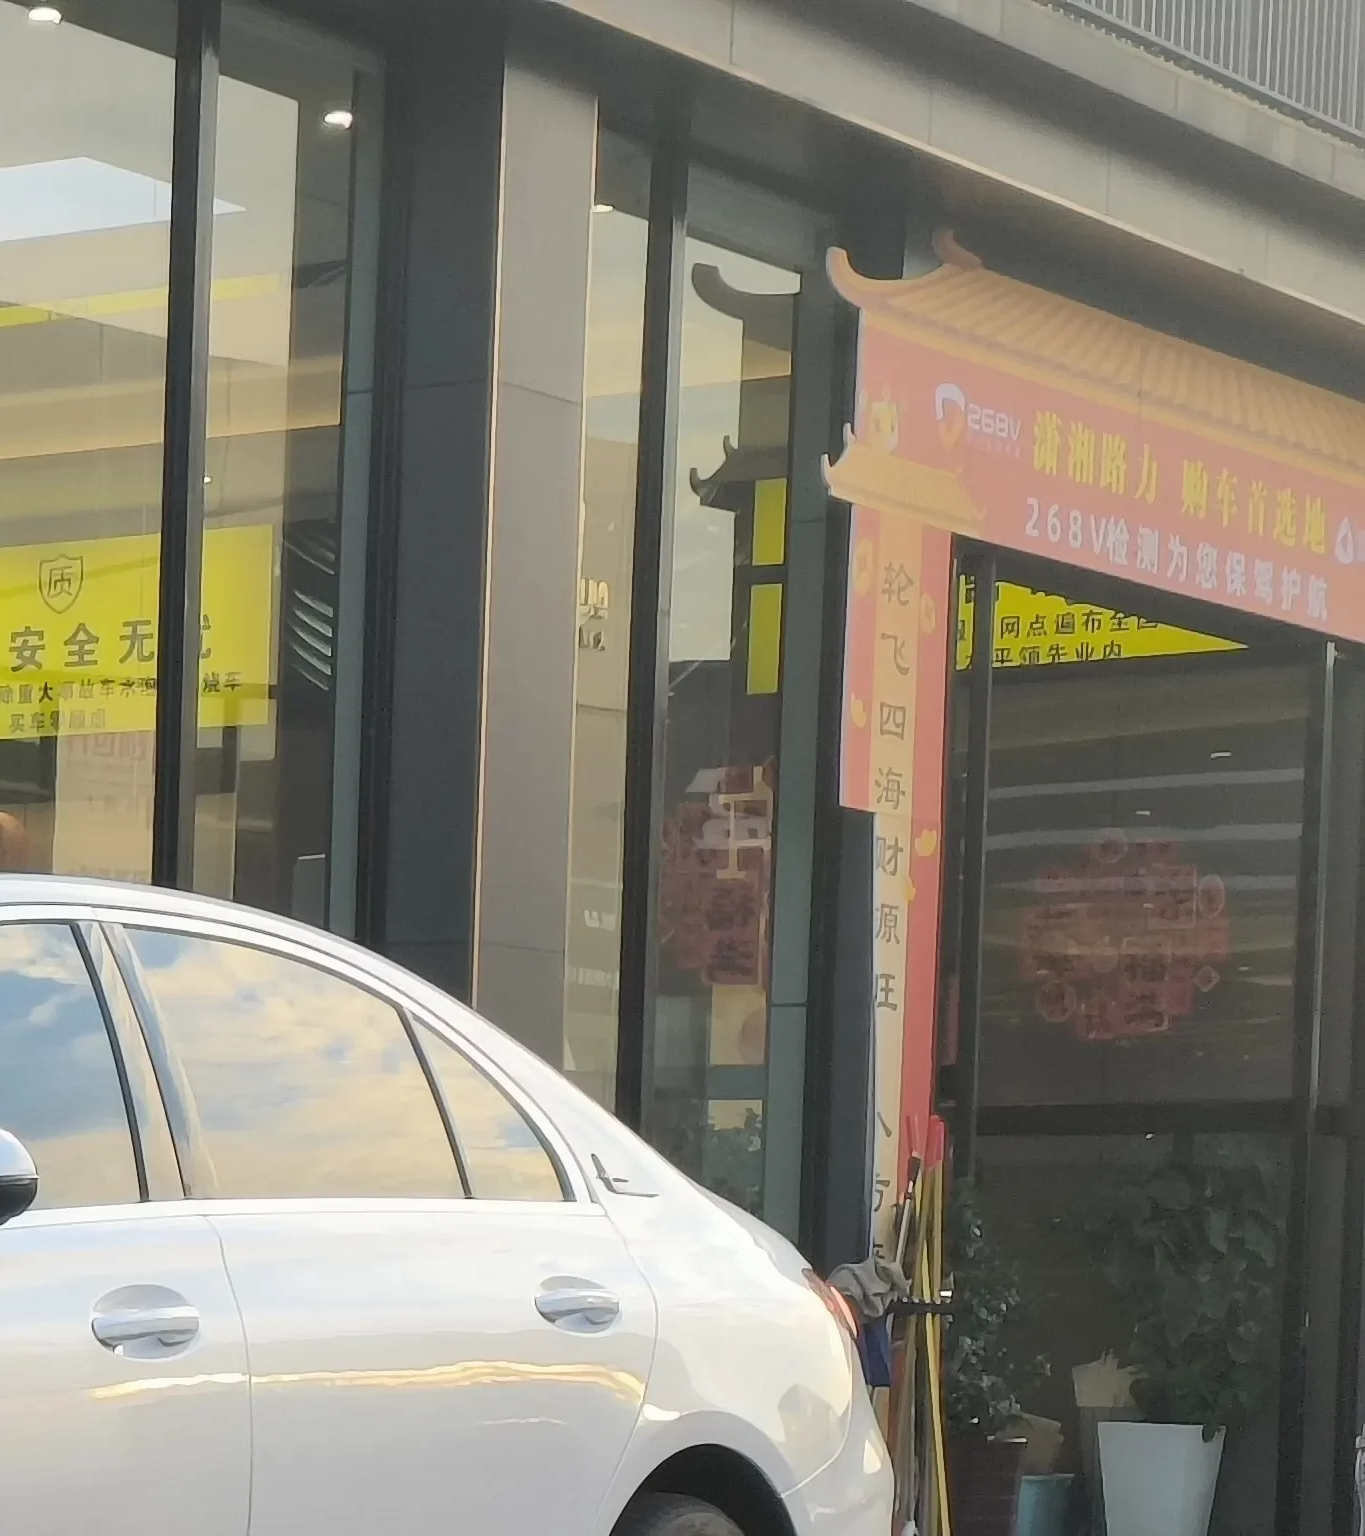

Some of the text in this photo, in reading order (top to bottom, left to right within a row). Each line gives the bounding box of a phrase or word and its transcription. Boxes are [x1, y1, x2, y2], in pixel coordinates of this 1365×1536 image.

[967, 403, 1021, 441] 268V
[1180, 457, 1327, 555] 购车首选地
[47, 566, 74, 598] 质
